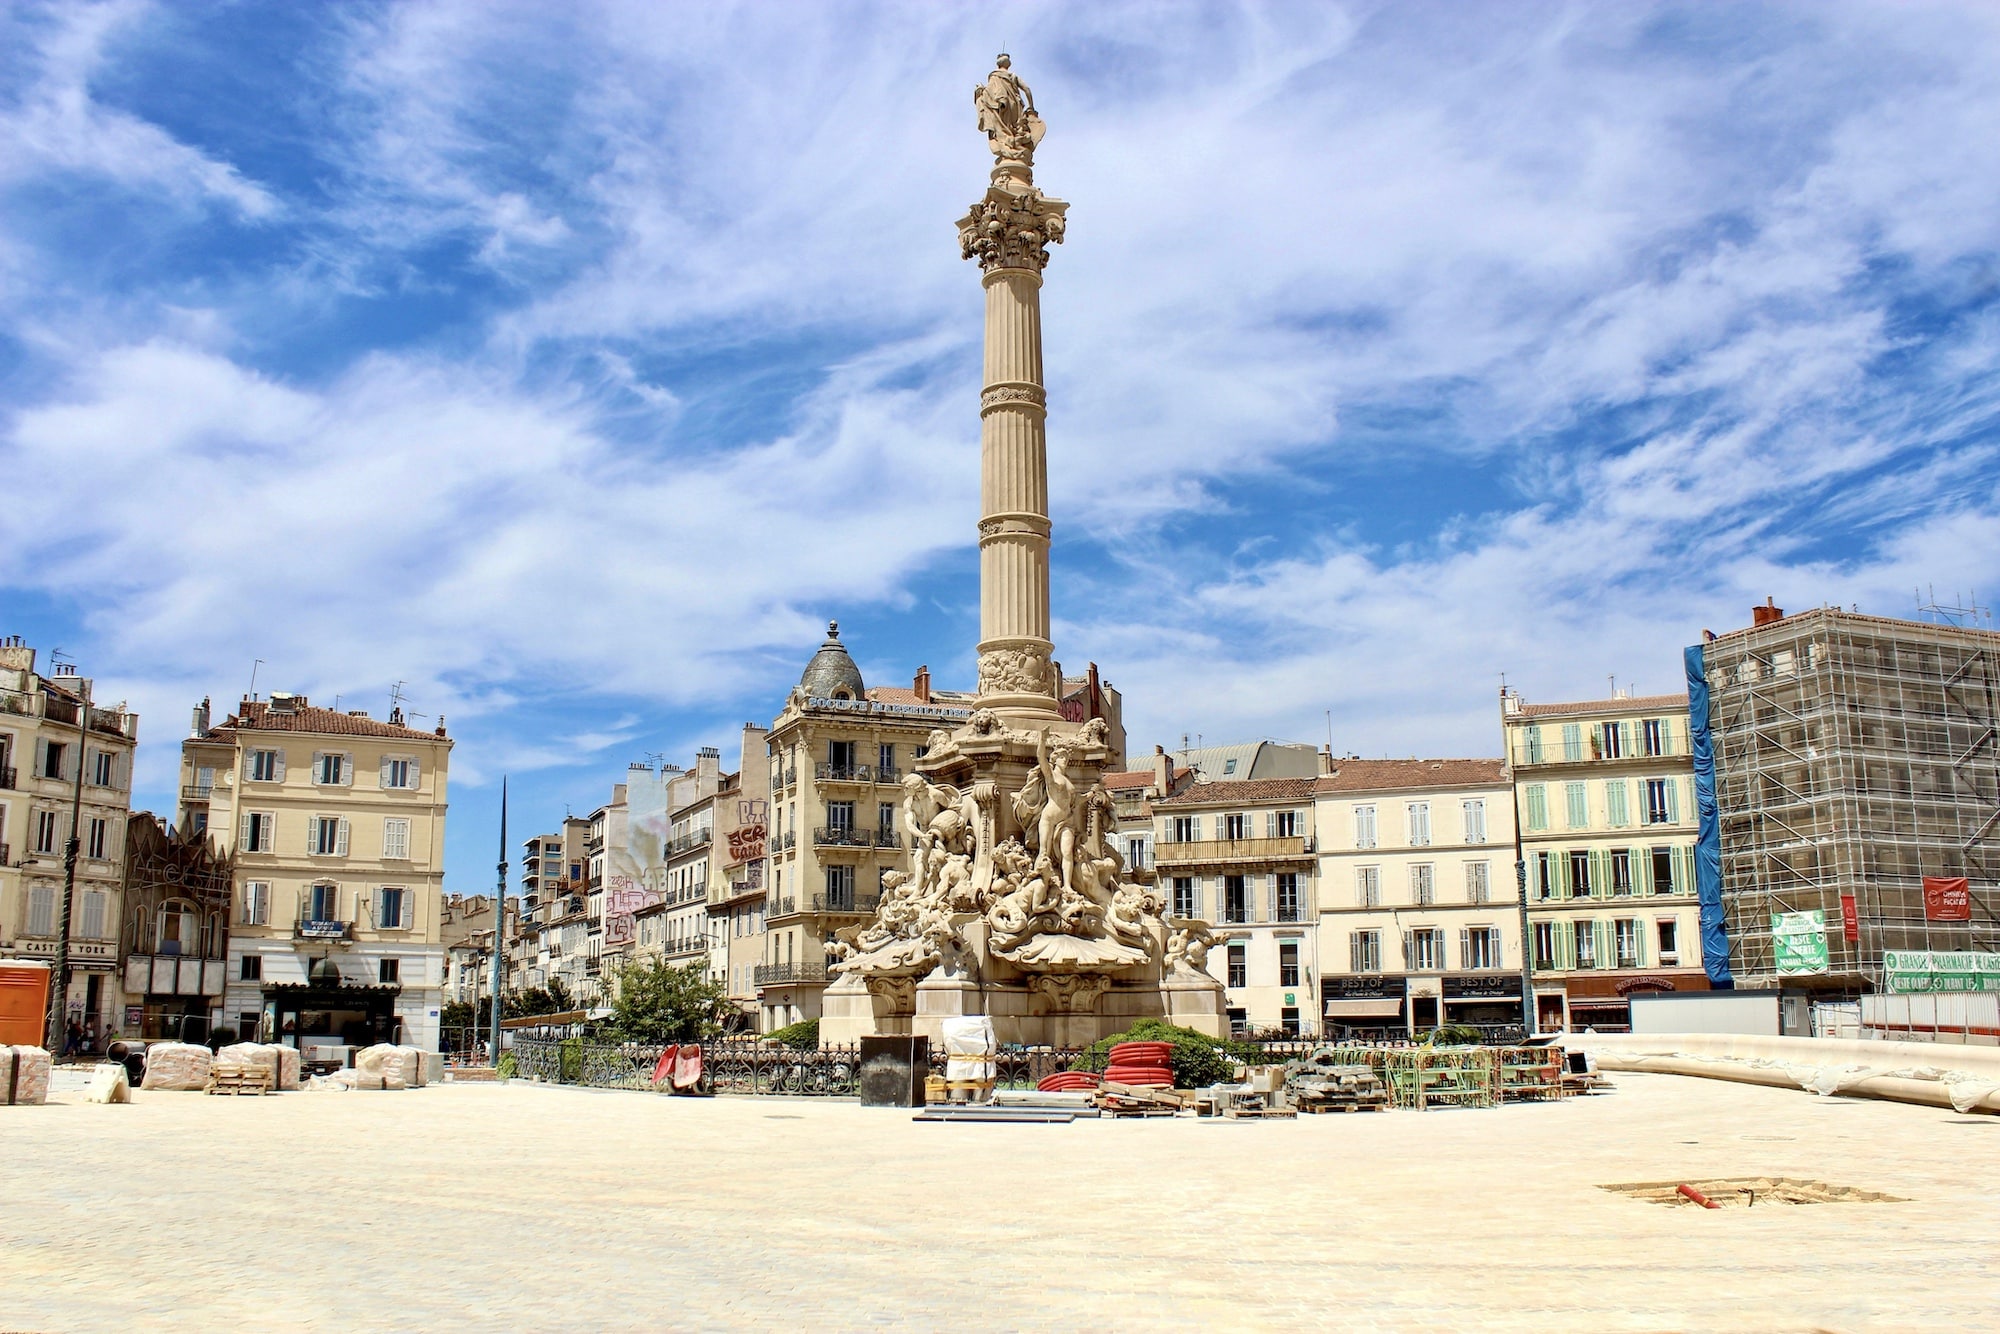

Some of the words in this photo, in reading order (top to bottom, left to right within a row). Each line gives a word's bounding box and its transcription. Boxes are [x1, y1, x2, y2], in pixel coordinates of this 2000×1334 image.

[79, 946, 106, 954] YORK
[1932, 954, 1973, 970] PHARMACIE
[1341, 979, 1366, 989] BEST
[1369, 979, 1383, 988] OF
[1460, 978, 1486, 987] BEST
[1488, 977, 1503, 986] OF
